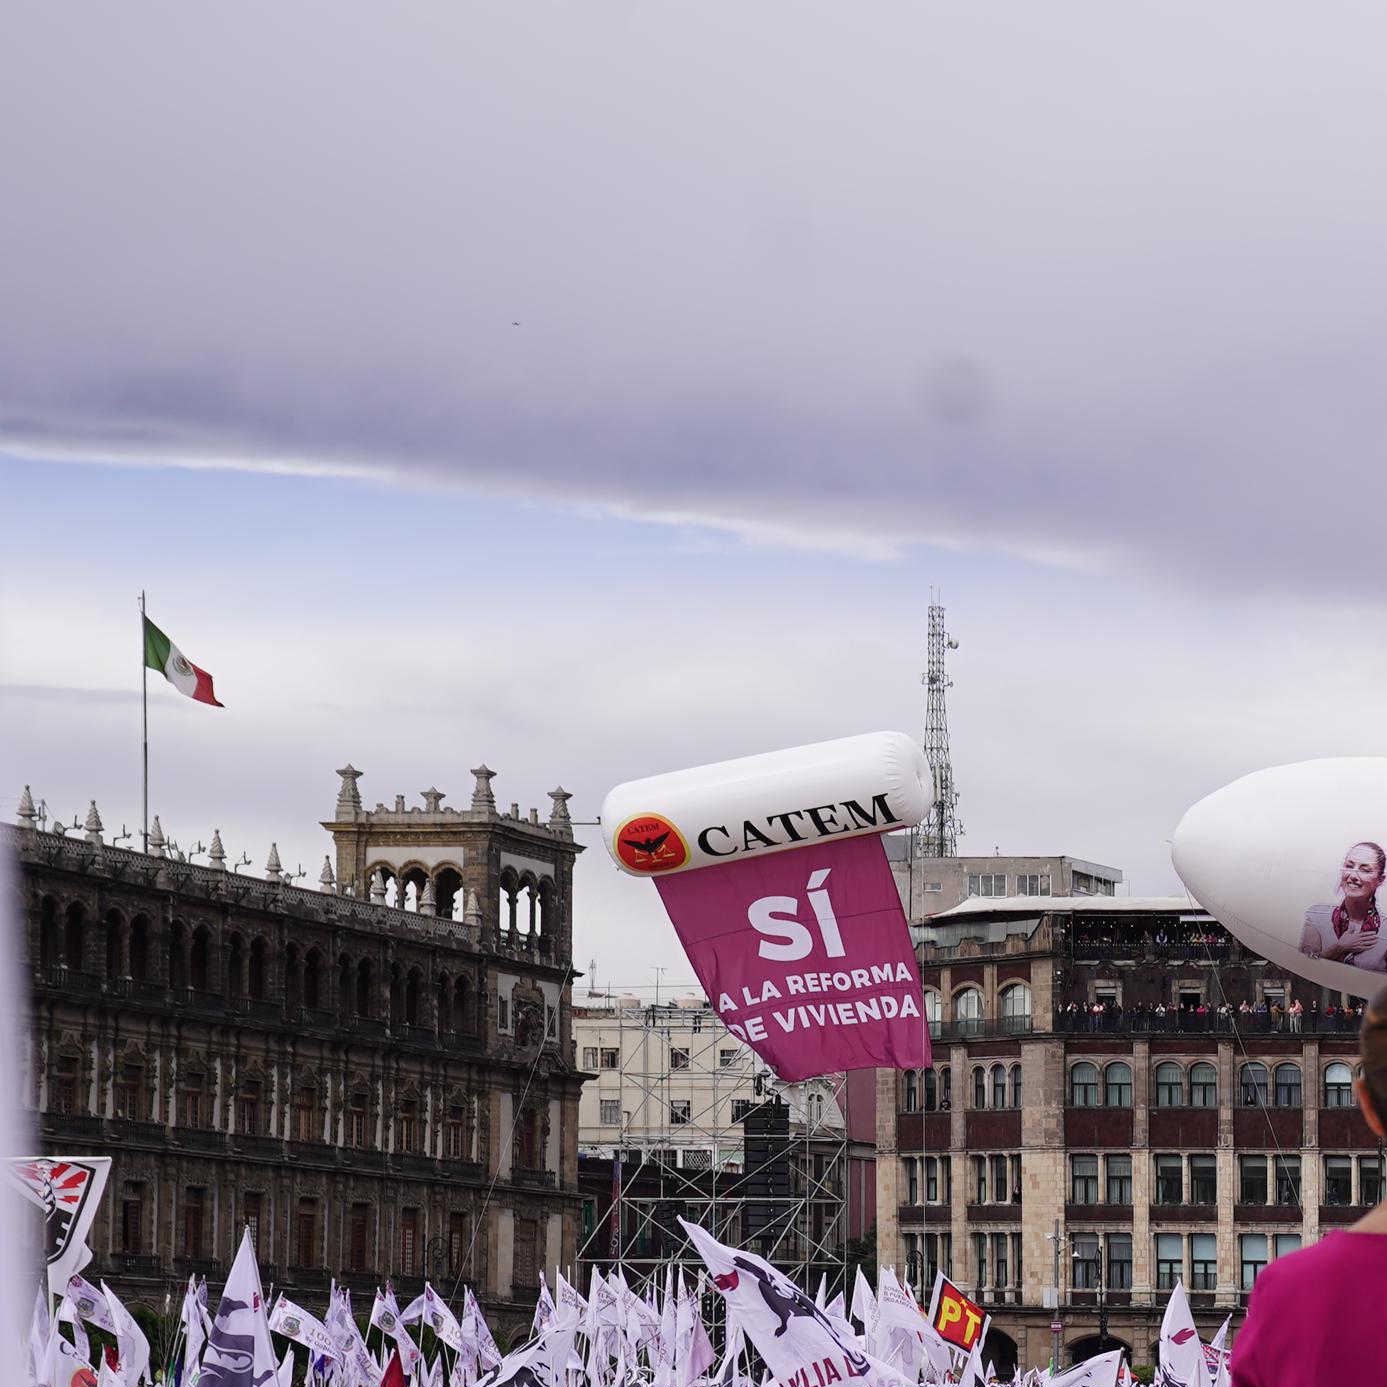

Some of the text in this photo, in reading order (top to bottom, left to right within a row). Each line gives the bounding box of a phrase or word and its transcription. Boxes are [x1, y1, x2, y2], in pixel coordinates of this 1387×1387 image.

[697, 793, 903, 857] CATEM
[747, 868, 847, 962] SÍ
[718, 962, 914, 1014] A LA REFORMA
[727, 994, 921, 1044] DE VIVIENDA
[937, 1295, 983, 1346] PT
